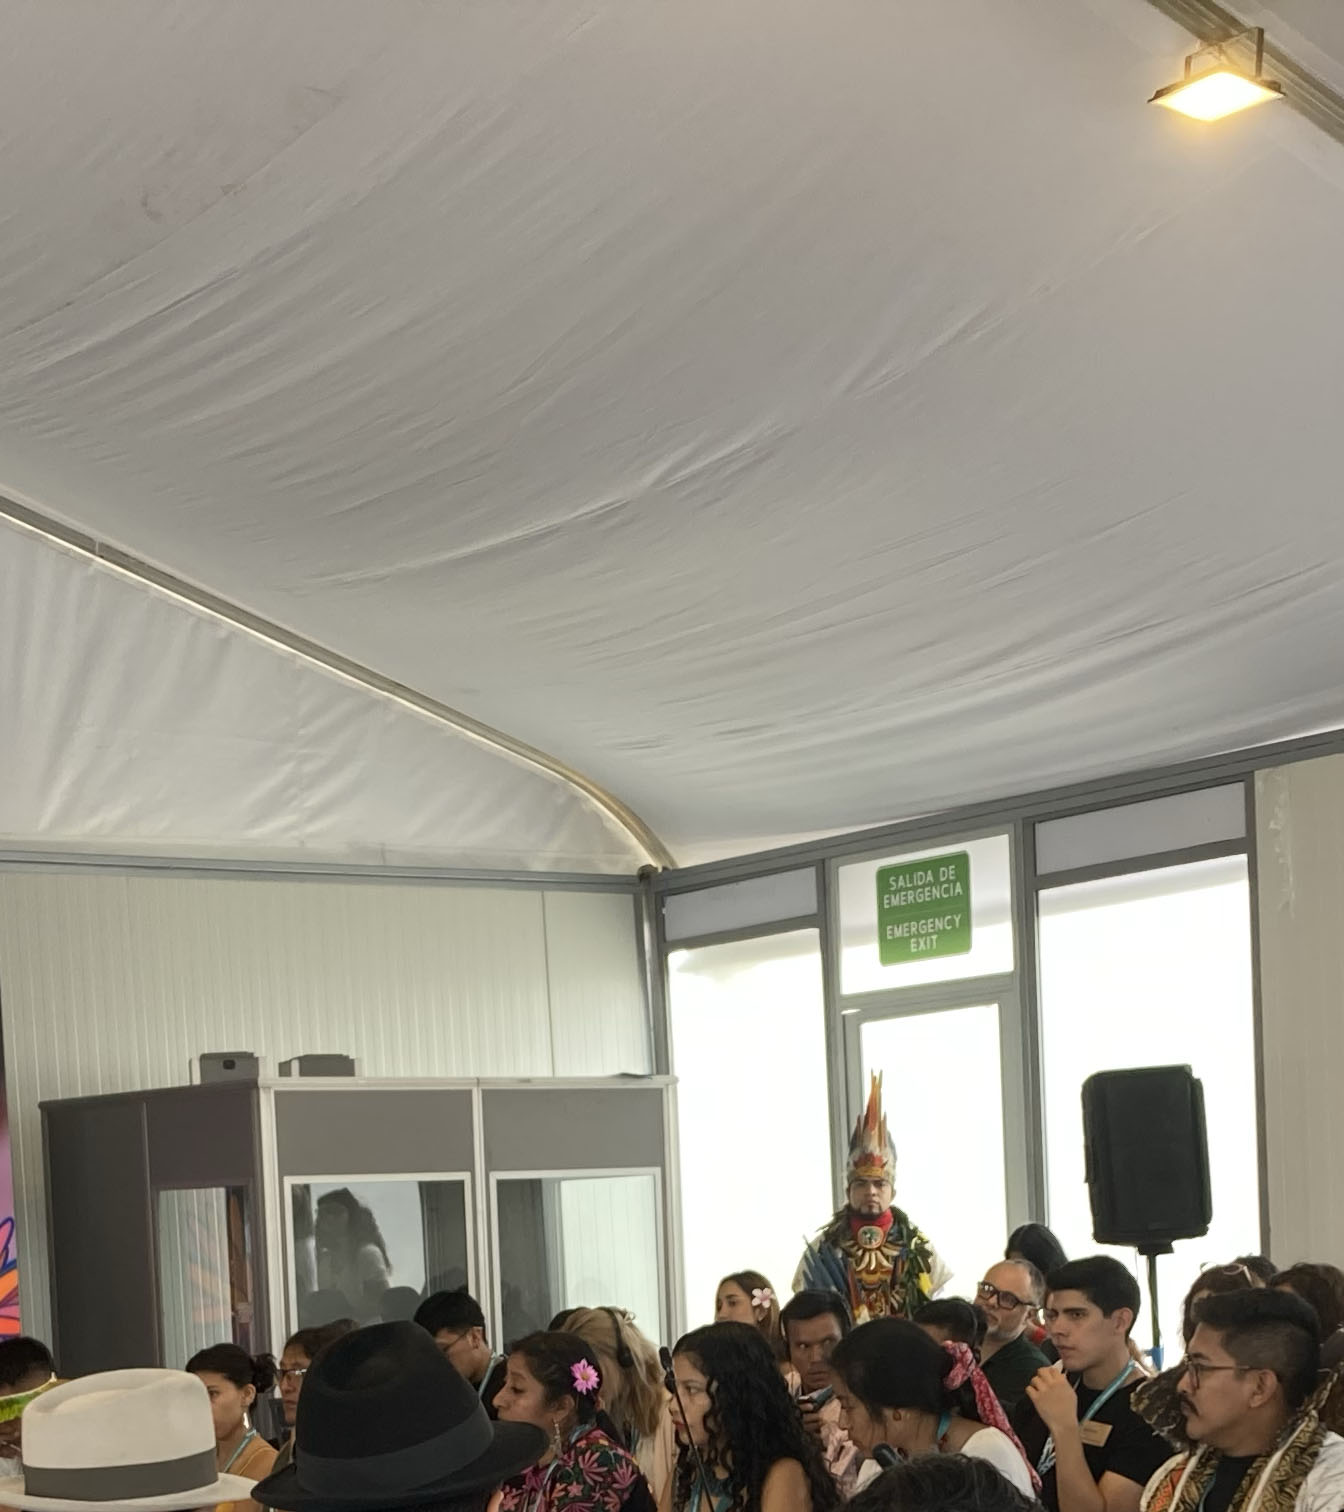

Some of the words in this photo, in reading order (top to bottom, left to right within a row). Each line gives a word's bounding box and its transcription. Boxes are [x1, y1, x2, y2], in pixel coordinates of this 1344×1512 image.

[889, 870, 934, 891] SALIDA
[939, 865, 956, 881] DE
[883, 882, 963, 909] EMERGENCIA
[886, 914, 961, 940] EMERGENCY
[910, 934, 938, 953] EXIT
